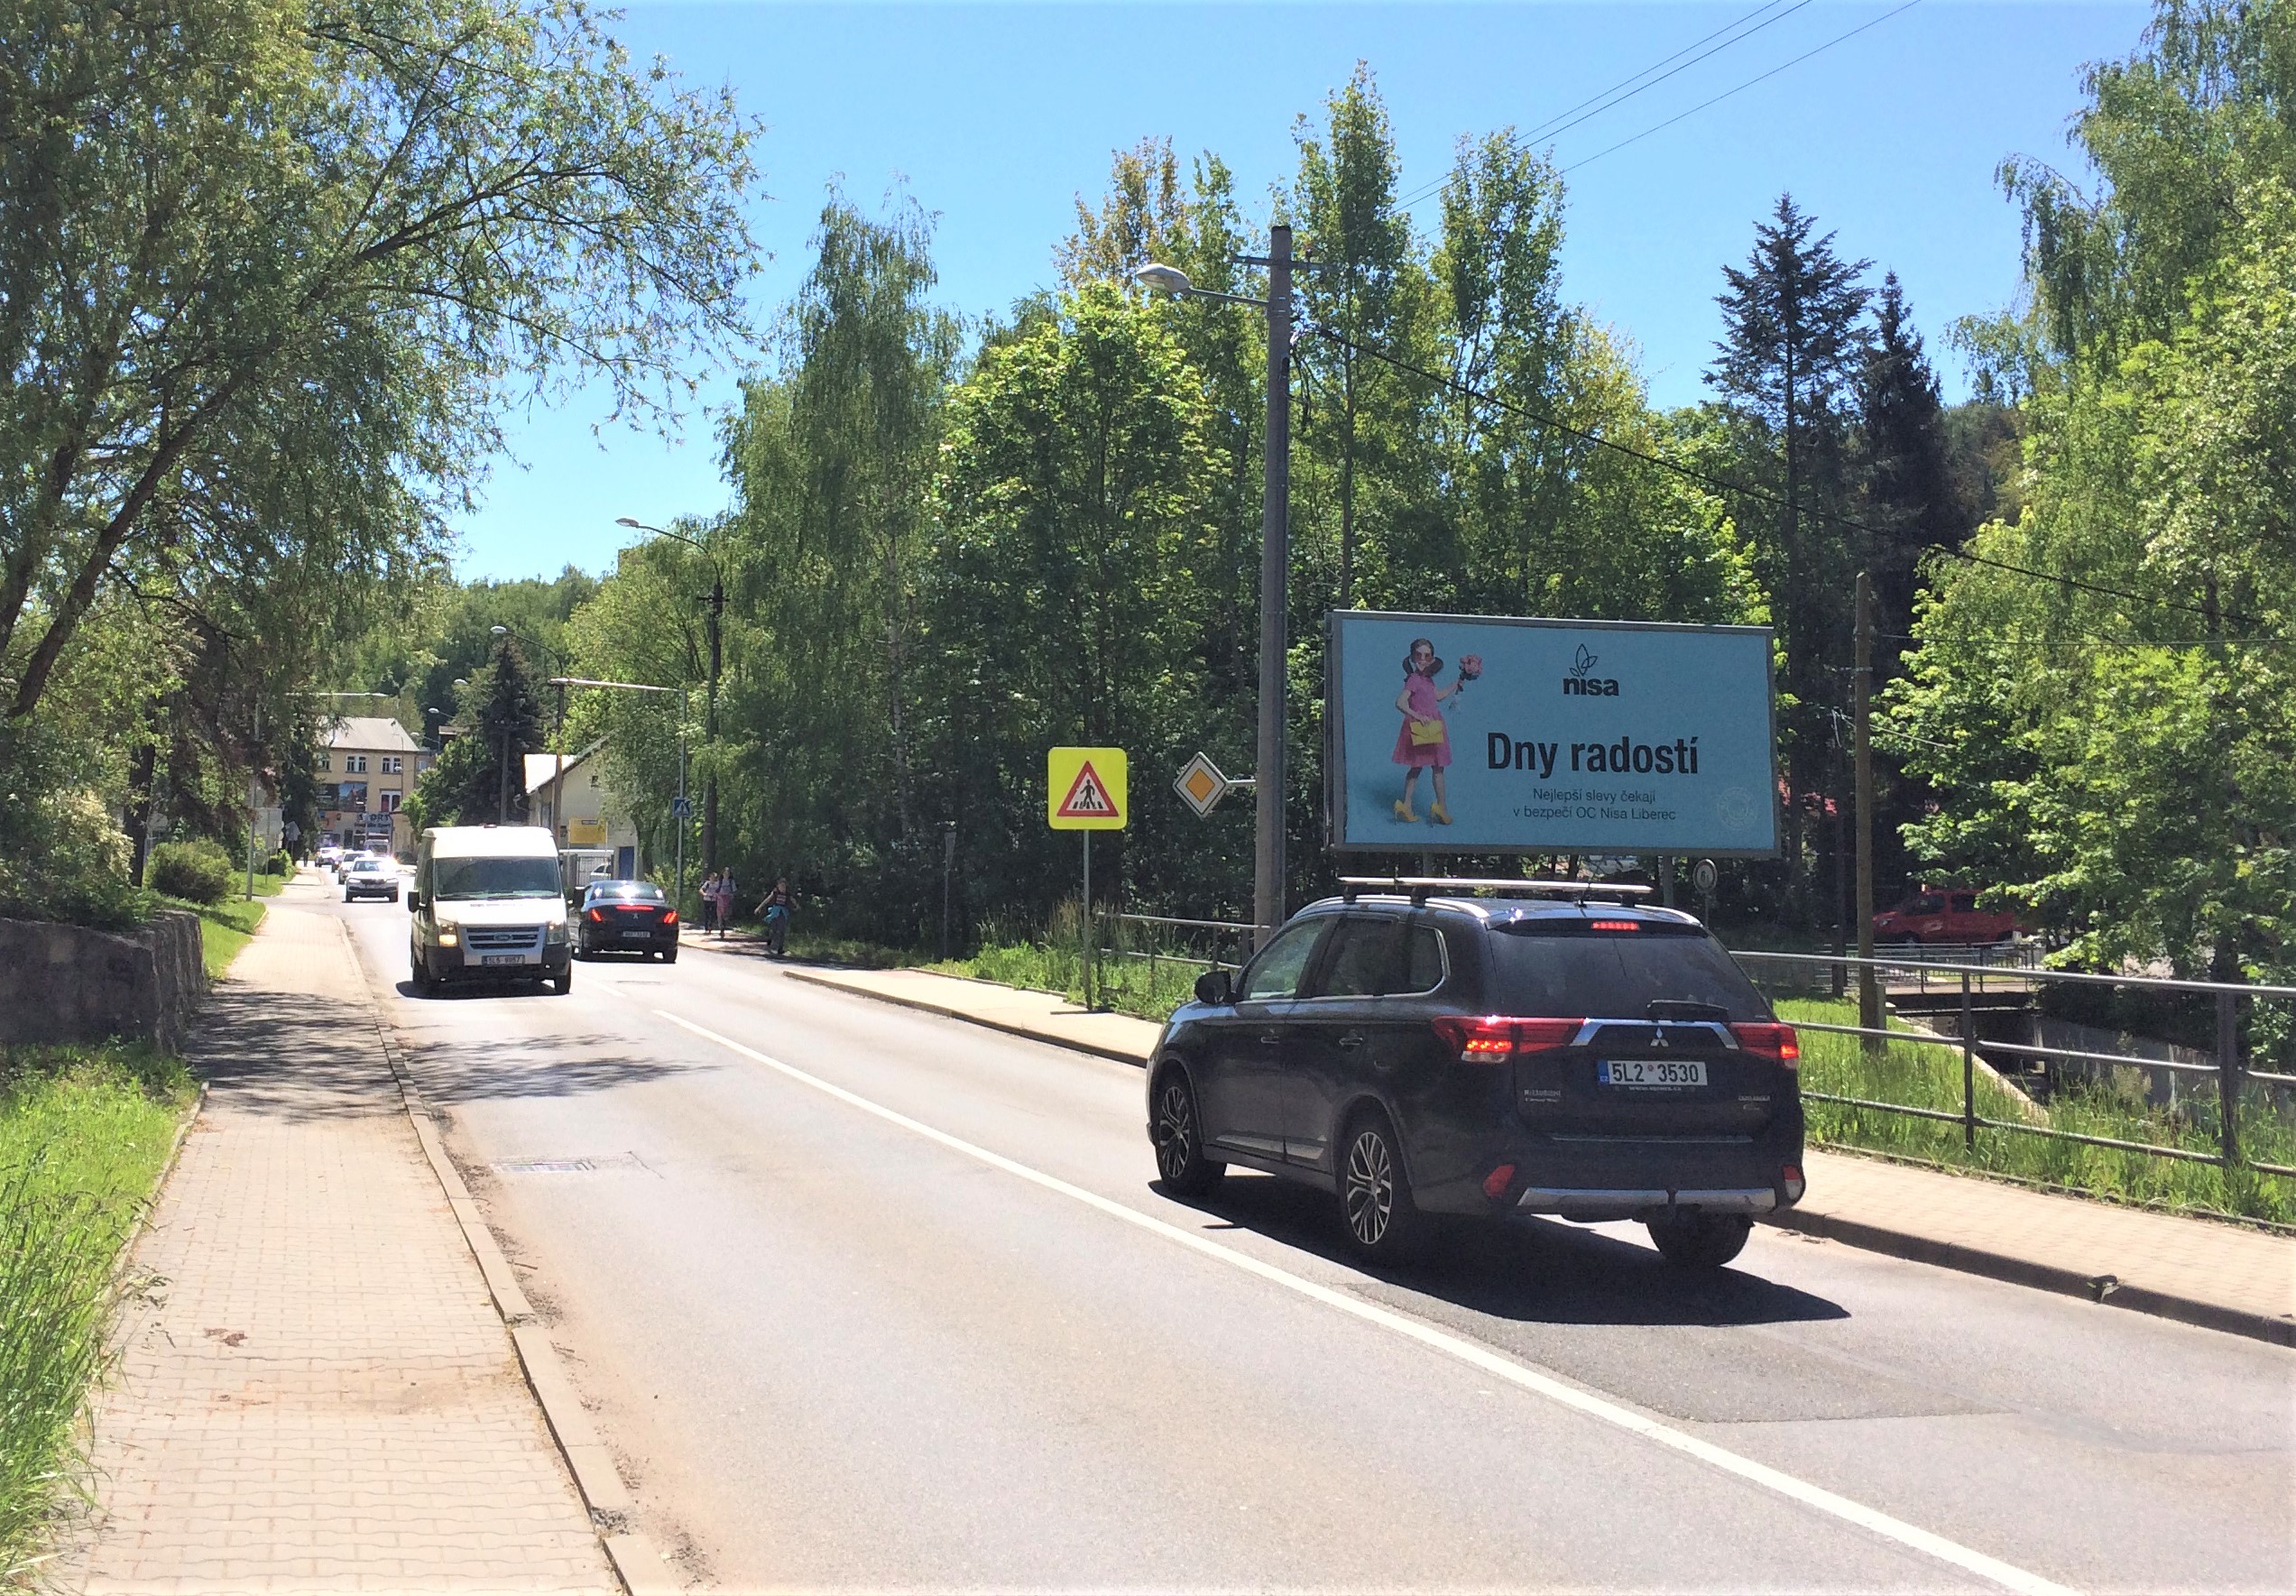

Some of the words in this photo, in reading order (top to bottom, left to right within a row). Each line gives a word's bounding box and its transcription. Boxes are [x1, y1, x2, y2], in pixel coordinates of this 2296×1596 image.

[1563, 677, 1619, 697] nisa
[1488, 732, 1559, 780] Dny
[1571, 735, 1699, 774] radostí
[1533, 788, 1582, 803] Nejlepší
[1586, 789, 1618, 805] slevy
[1620, 789, 1656, 805] čekají
[1513, 807, 1520, 817] v
[1524, 805, 1573, 820] bezpečí
[1576, 806, 1597, 819] OC
[1600, 807, 1627, 820] Nisa
[1631, 807, 1676, 821] Liberec
[1611, 1063, 1645, 1083] 5L2
[1657, 1063, 1700, 1084] 3530
